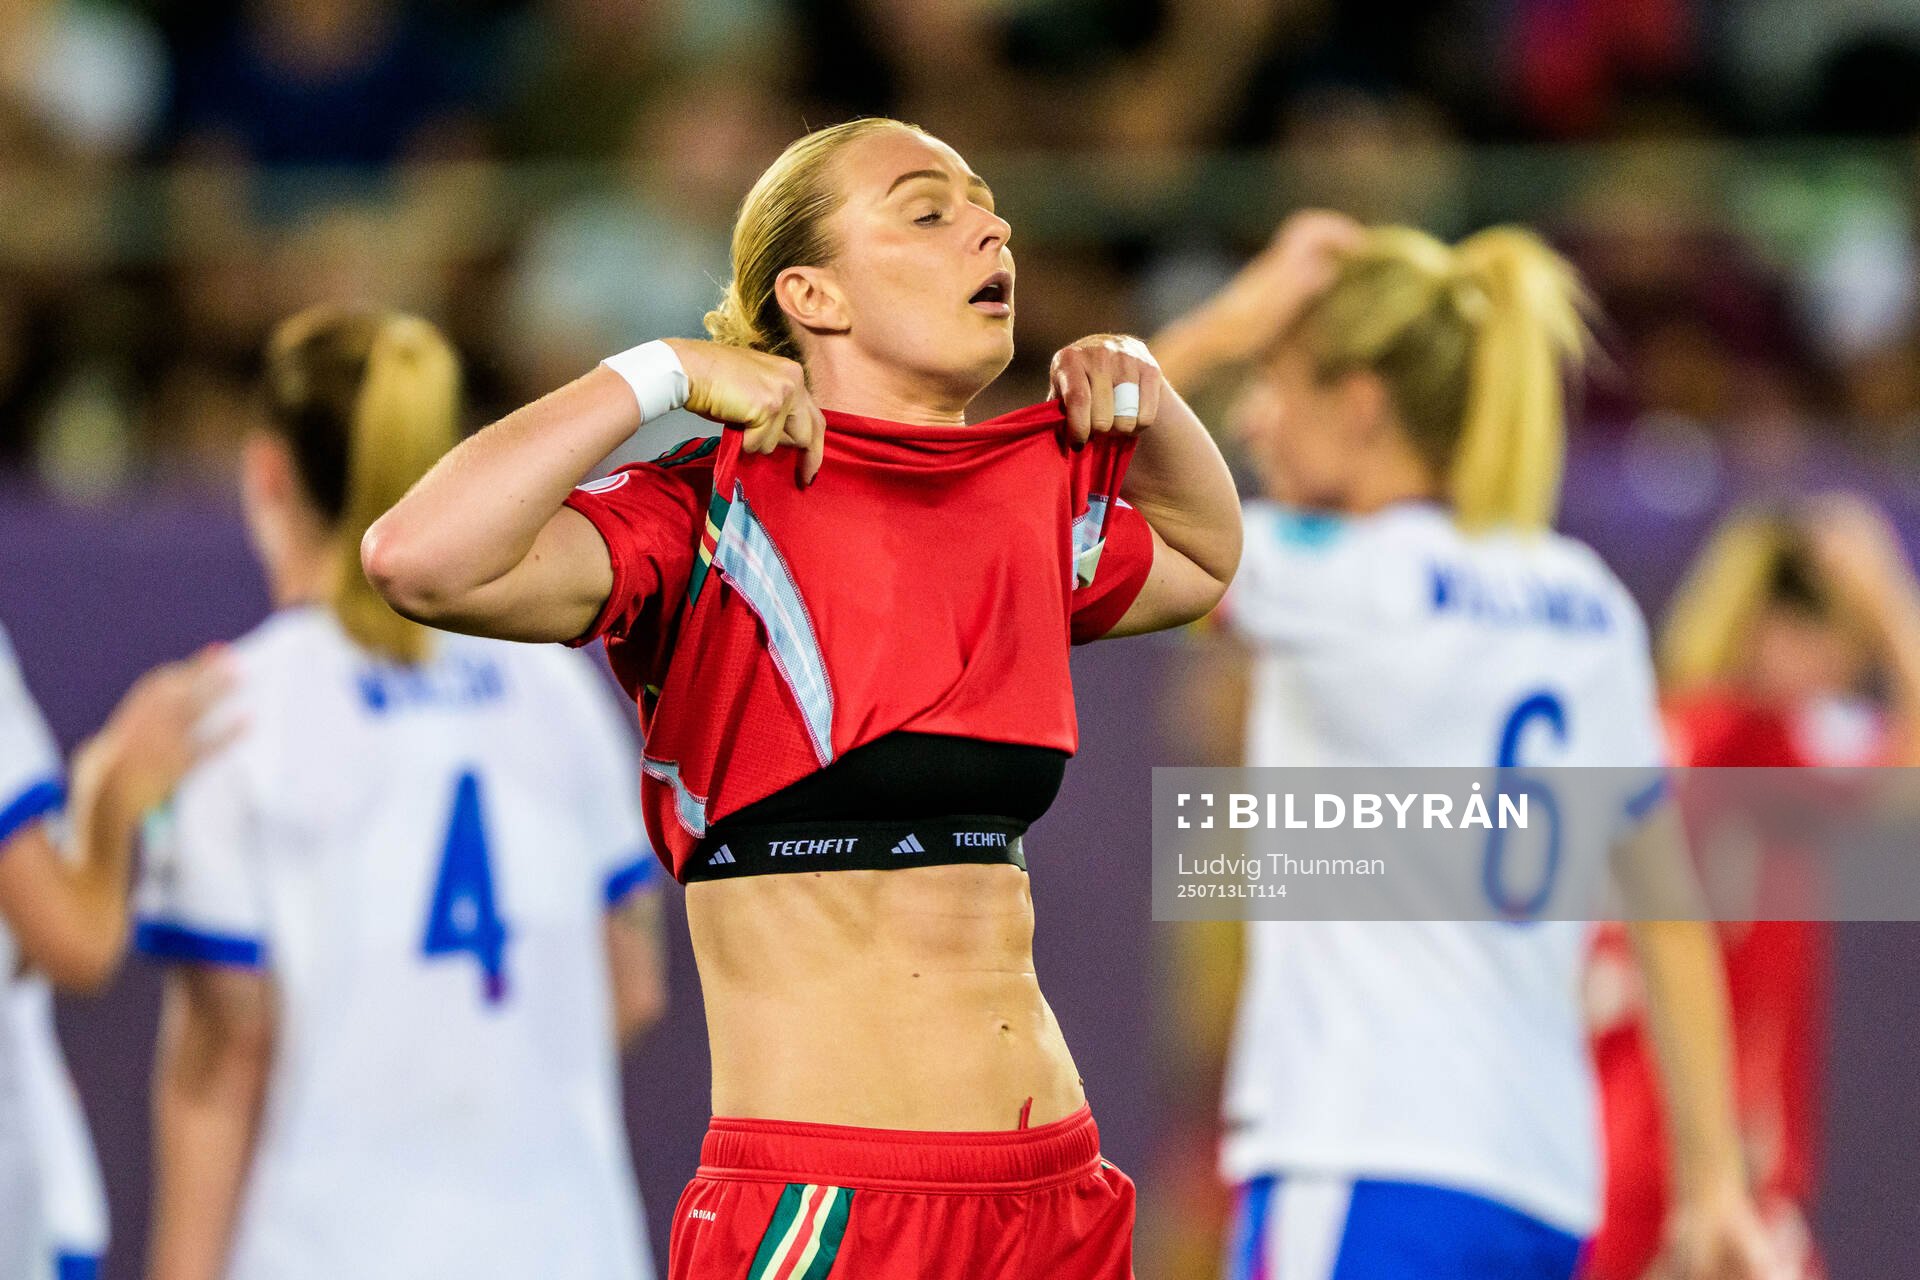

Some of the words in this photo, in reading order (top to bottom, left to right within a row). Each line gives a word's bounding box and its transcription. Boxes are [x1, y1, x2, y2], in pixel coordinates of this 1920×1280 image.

[419, 770, 508, 1007] 4
[768, 838, 858, 857] TECHFIT
[952, 832, 1007, 847] TECHFIT
[1483, 691, 1566, 926] 6
